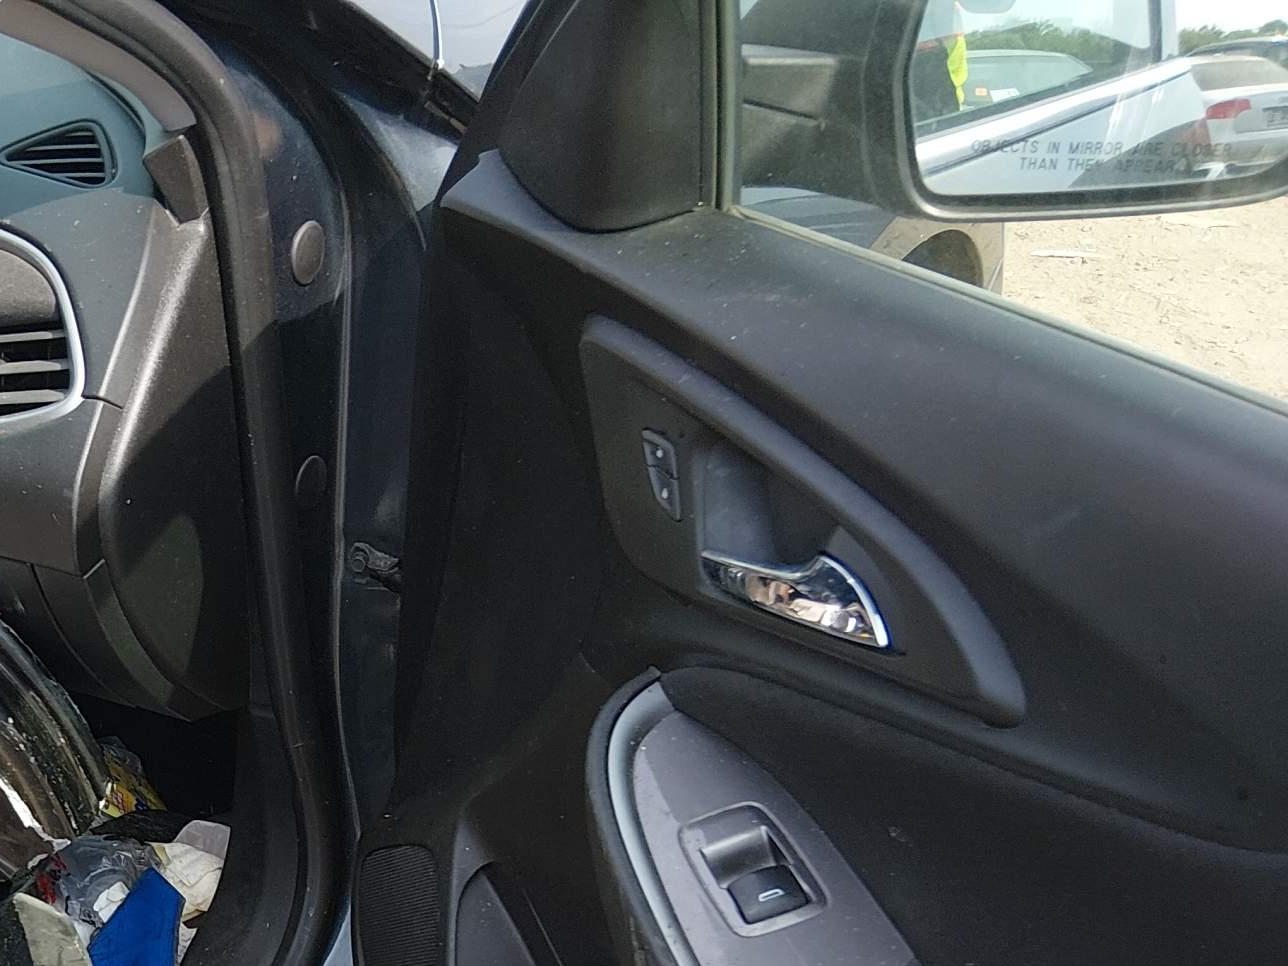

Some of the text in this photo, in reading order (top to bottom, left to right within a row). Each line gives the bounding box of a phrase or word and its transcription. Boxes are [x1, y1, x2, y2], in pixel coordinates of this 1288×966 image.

[971, 139, 1040, 153] OBJECTS
[1047, 142, 1061, 154] IN
[1068, 141, 1124, 155] MIRROR
[1131, 142, 1161, 156] ARE
[1019, 157, 1058, 170] THAN
